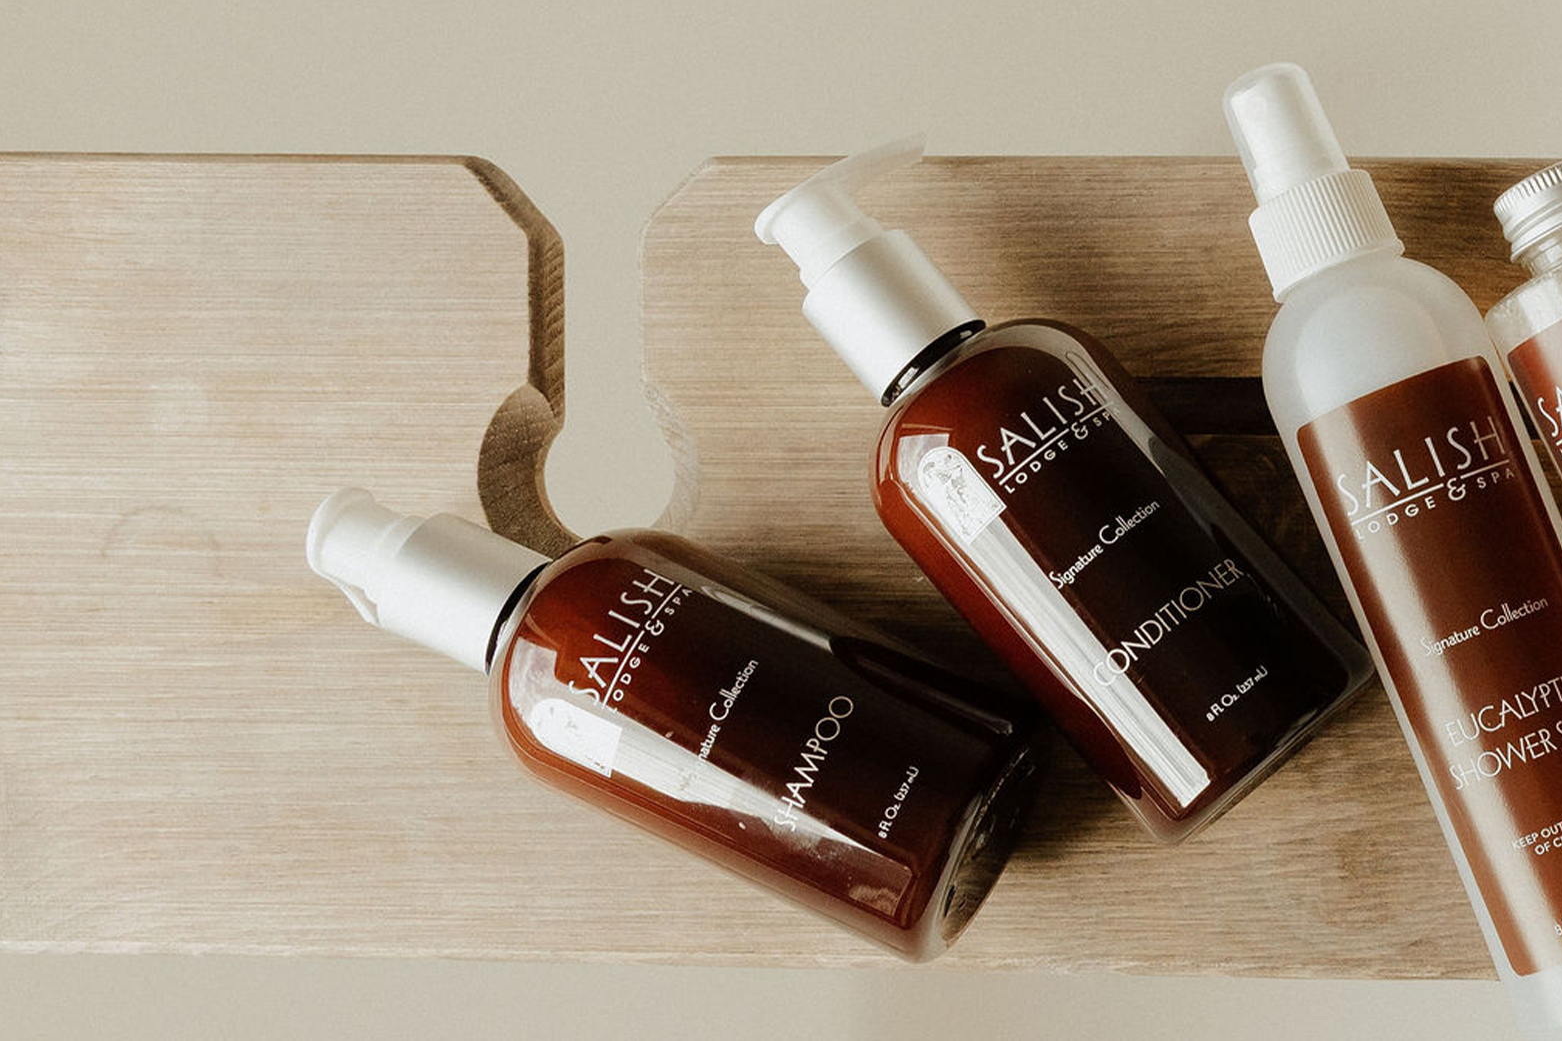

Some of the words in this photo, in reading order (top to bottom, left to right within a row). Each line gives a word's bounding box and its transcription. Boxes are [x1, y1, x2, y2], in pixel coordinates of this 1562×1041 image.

[976, 373, 1109, 479] SALISH
[1004, 439, 1069, 494] LODGE
[1071, 421, 1089, 440] &
[1337, 416, 1506, 517] SALISH
[1355, 496, 1436, 540] LODGE
[1446, 477, 1466, 501] &
[1477, 468, 1515, 489] SPA
[1049, 544, 1104, 589] Signature
[1099, 501, 1160, 545] Collection
[568, 568, 675, 706] SALISH
[645, 619, 665, 636] &
[664, 588, 692, 615] SPA
[1094, 559, 1244, 686] CONDITIONER
[1419, 625, 1481, 657] Signature
[1480, 598, 1549, 630] Collection
[709, 659, 759, 721] Collection
[1206, 712, 1215, 722] 8
[1235, 677, 1254, 694] (237
[774, 696, 853, 832] SHAMPOO
[1449, 728, 1557, 790] SHOWER
[878, 831, 887, 839] 8
[1512, 832, 1539, 850] KEEP
[1534, 843, 1551, 856] OF
[1554, 921, 1562, 936] 8
